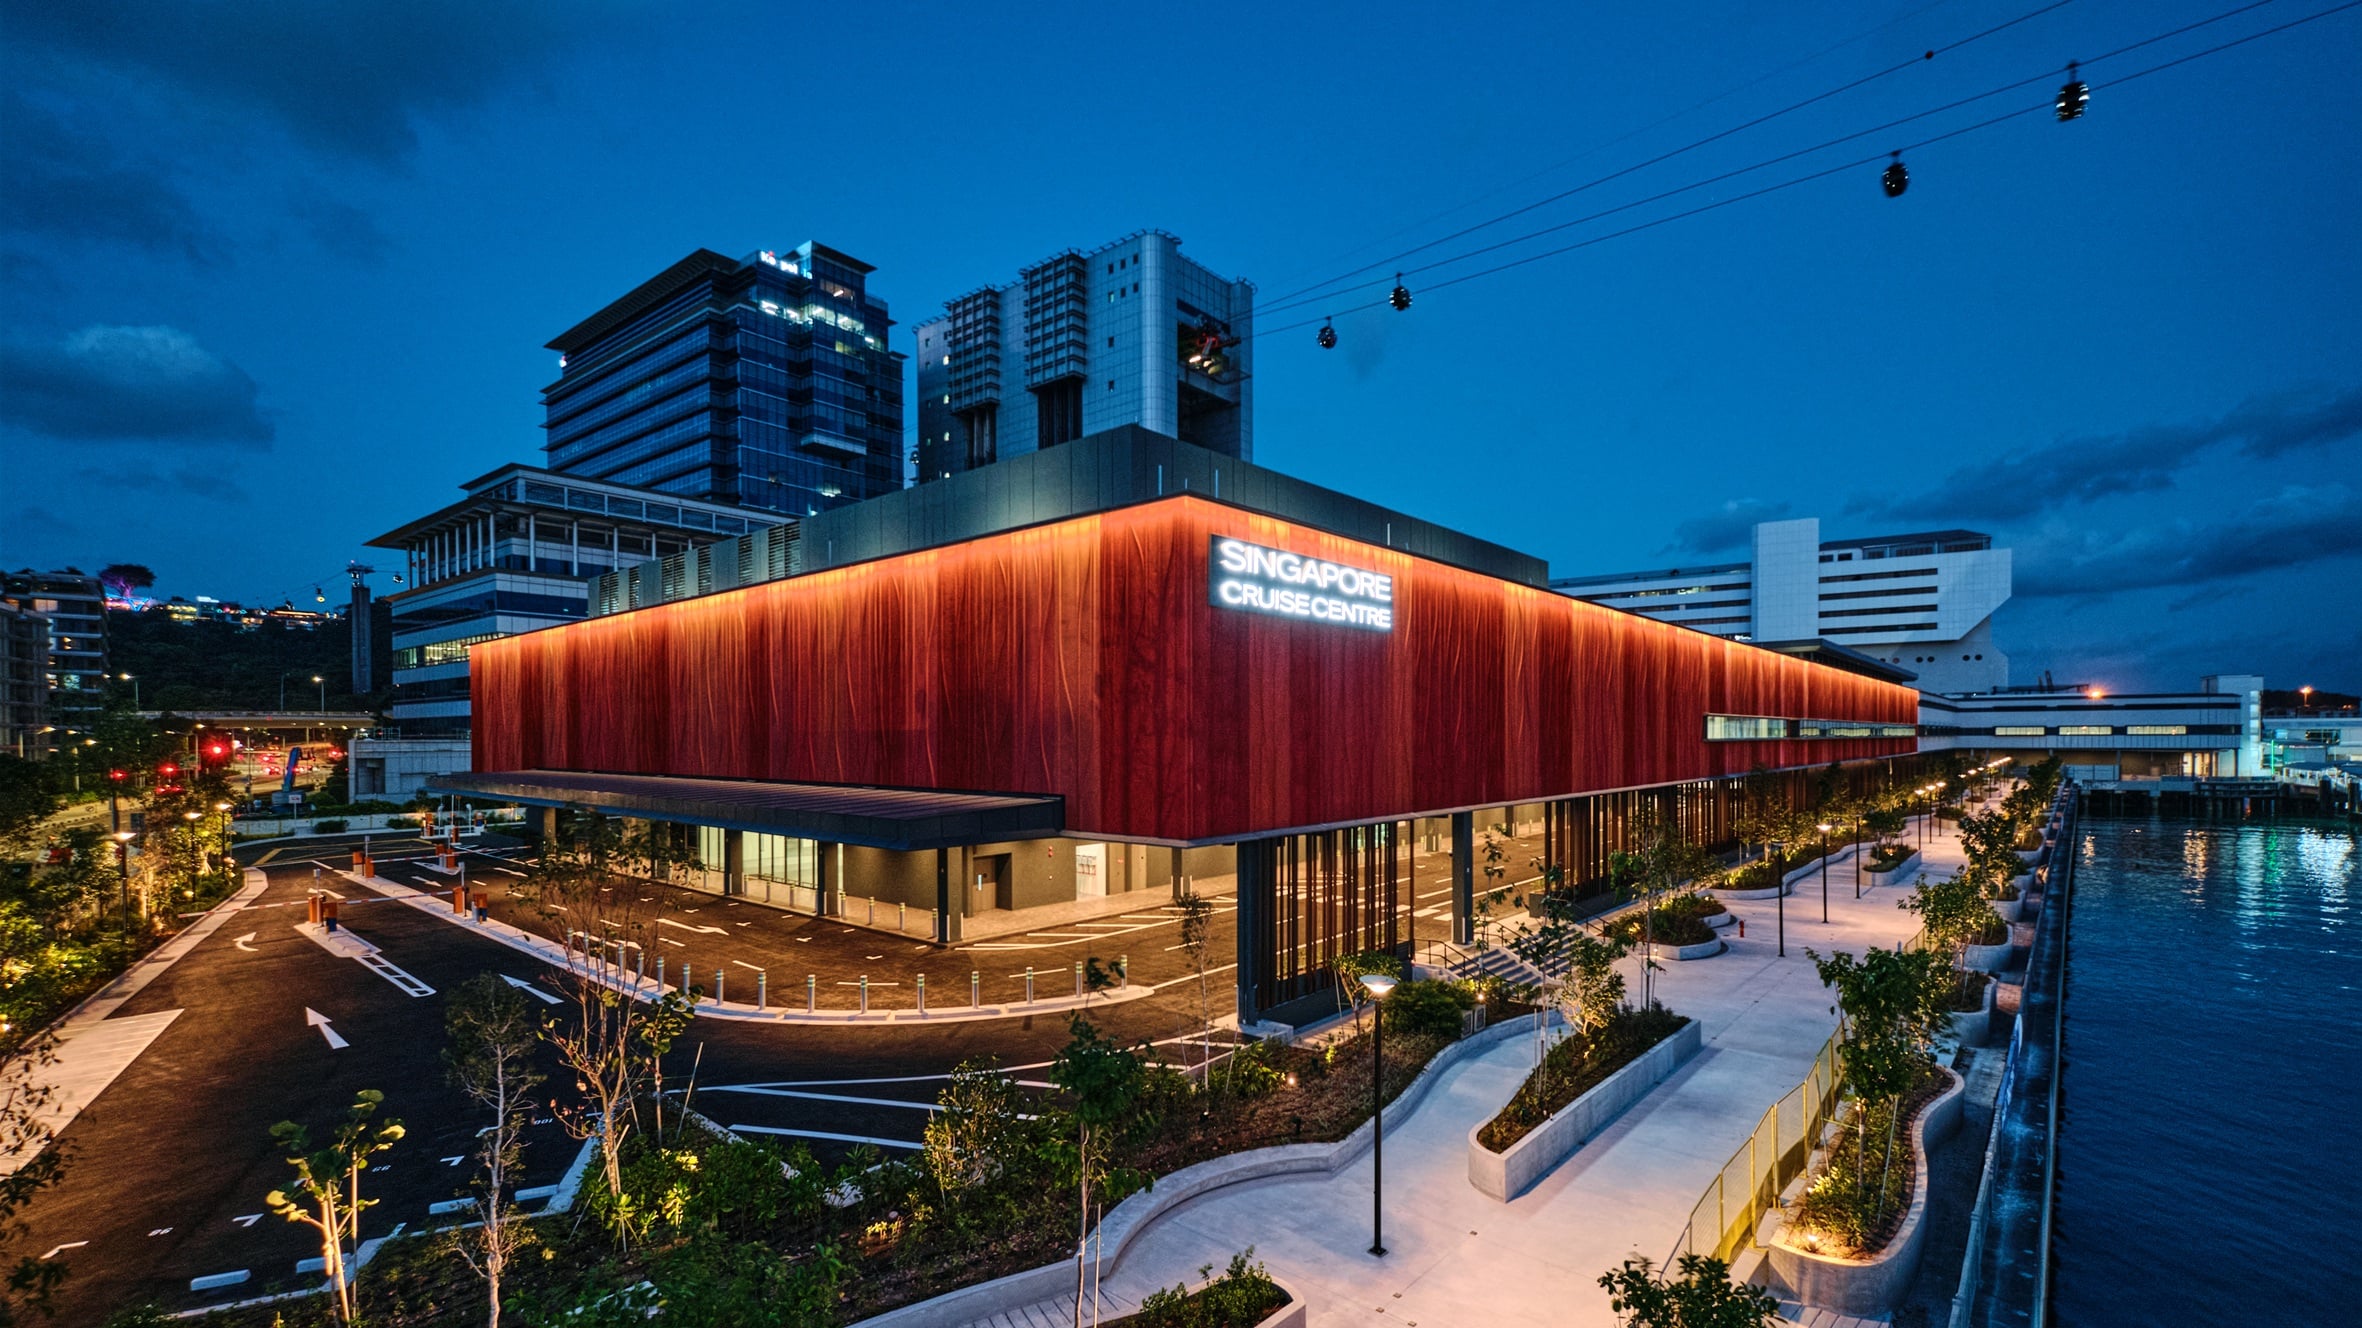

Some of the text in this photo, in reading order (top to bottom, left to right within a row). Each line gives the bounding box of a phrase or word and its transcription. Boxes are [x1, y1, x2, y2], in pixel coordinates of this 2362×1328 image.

[1219, 540, 1392, 601] SINGAPORE
[1219, 580, 1392, 628] CRUISE CENTRE
